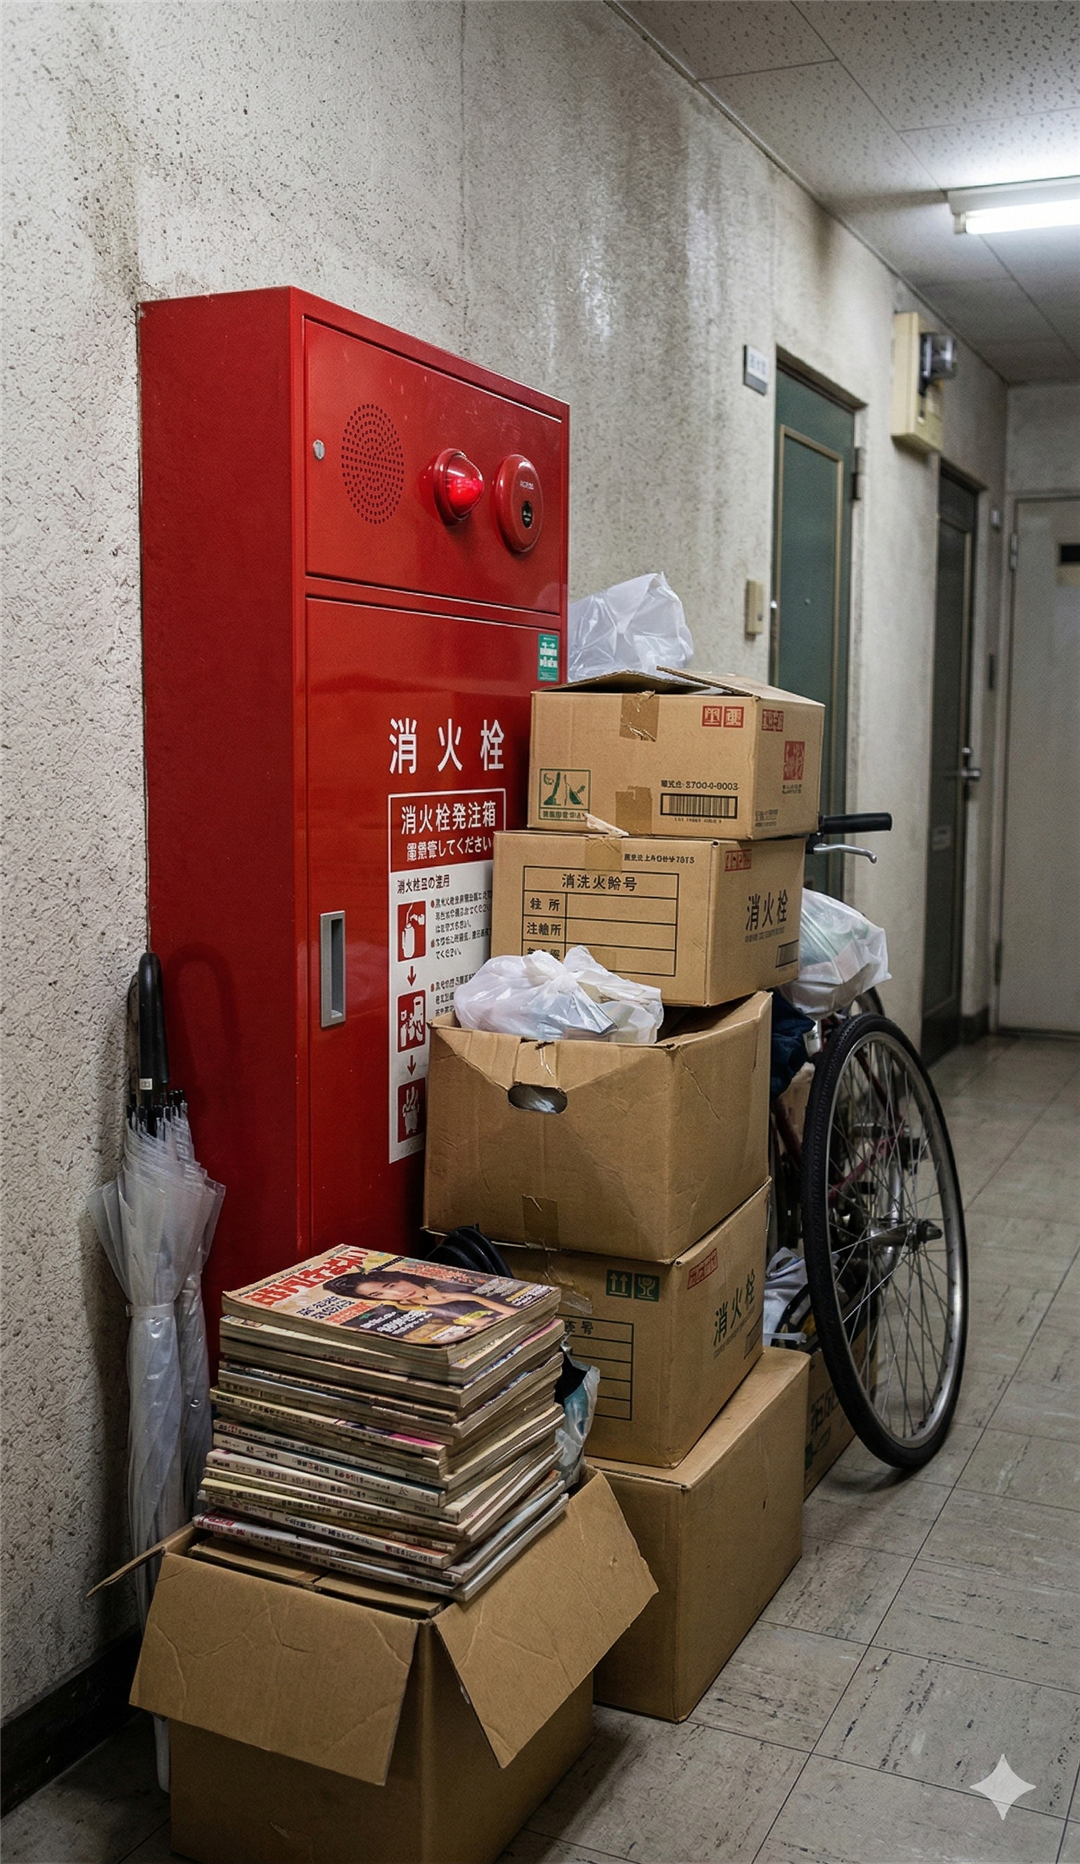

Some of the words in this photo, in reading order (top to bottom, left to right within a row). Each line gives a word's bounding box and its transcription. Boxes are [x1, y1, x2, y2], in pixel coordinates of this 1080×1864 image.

[389, 717, 505, 774] 消火栓
[401, 800, 497, 835] 消火栓発注箱
[745, 889, 788, 931] 消火栓
[713, 1268, 756, 1347] 消火栓
